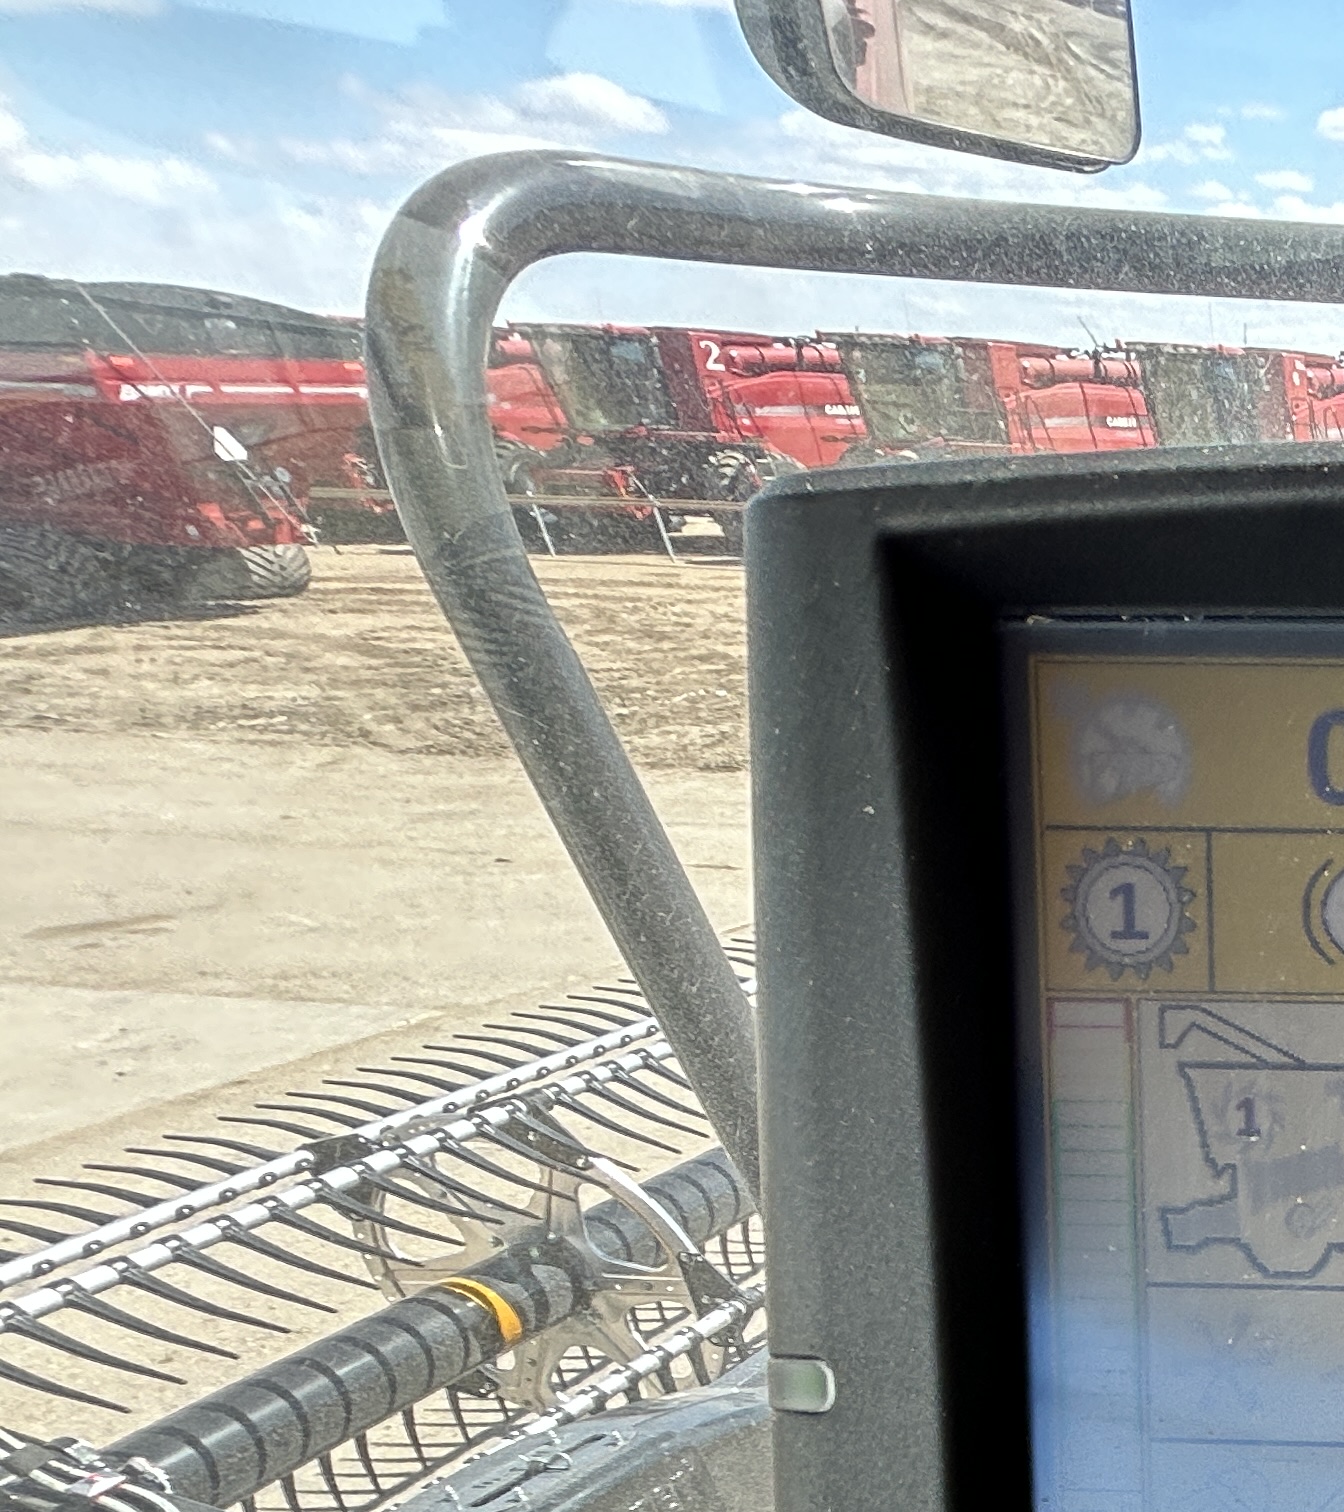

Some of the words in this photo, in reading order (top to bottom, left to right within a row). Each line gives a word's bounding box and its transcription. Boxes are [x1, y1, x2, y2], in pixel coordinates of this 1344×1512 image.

[700, 340, 725, 371] 2
[1108, 882, 1150, 941] 1
[1236, 1097, 1261, 1138] 1
